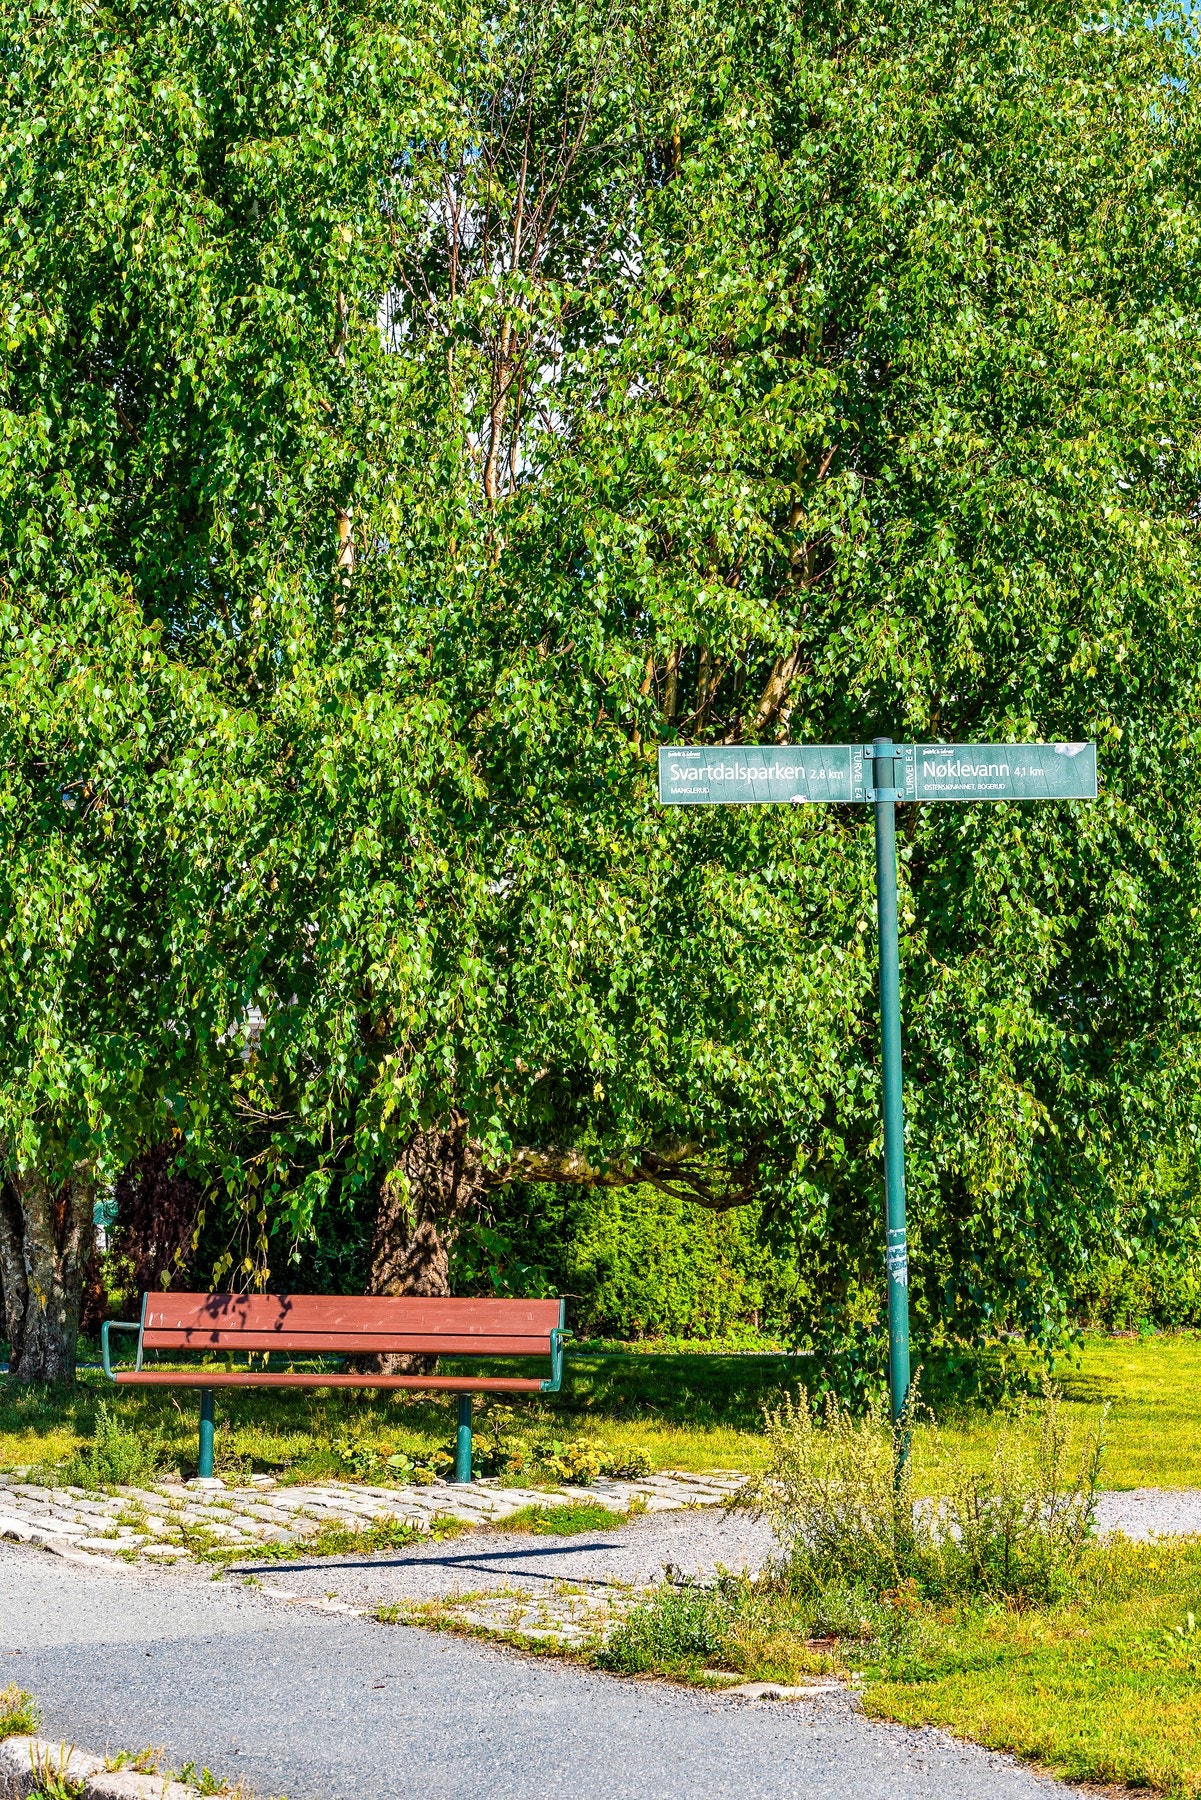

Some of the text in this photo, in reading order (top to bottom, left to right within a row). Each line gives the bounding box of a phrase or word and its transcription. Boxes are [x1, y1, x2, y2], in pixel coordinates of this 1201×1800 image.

[670, 762, 844, 784] Svartdalsparken 2,8 km
[853, 749, 863, 799] TURVEI E4
[905, 764, 914, 795] TURVEI
[922, 760, 1044, 778] Nøklevann 4,1 km
